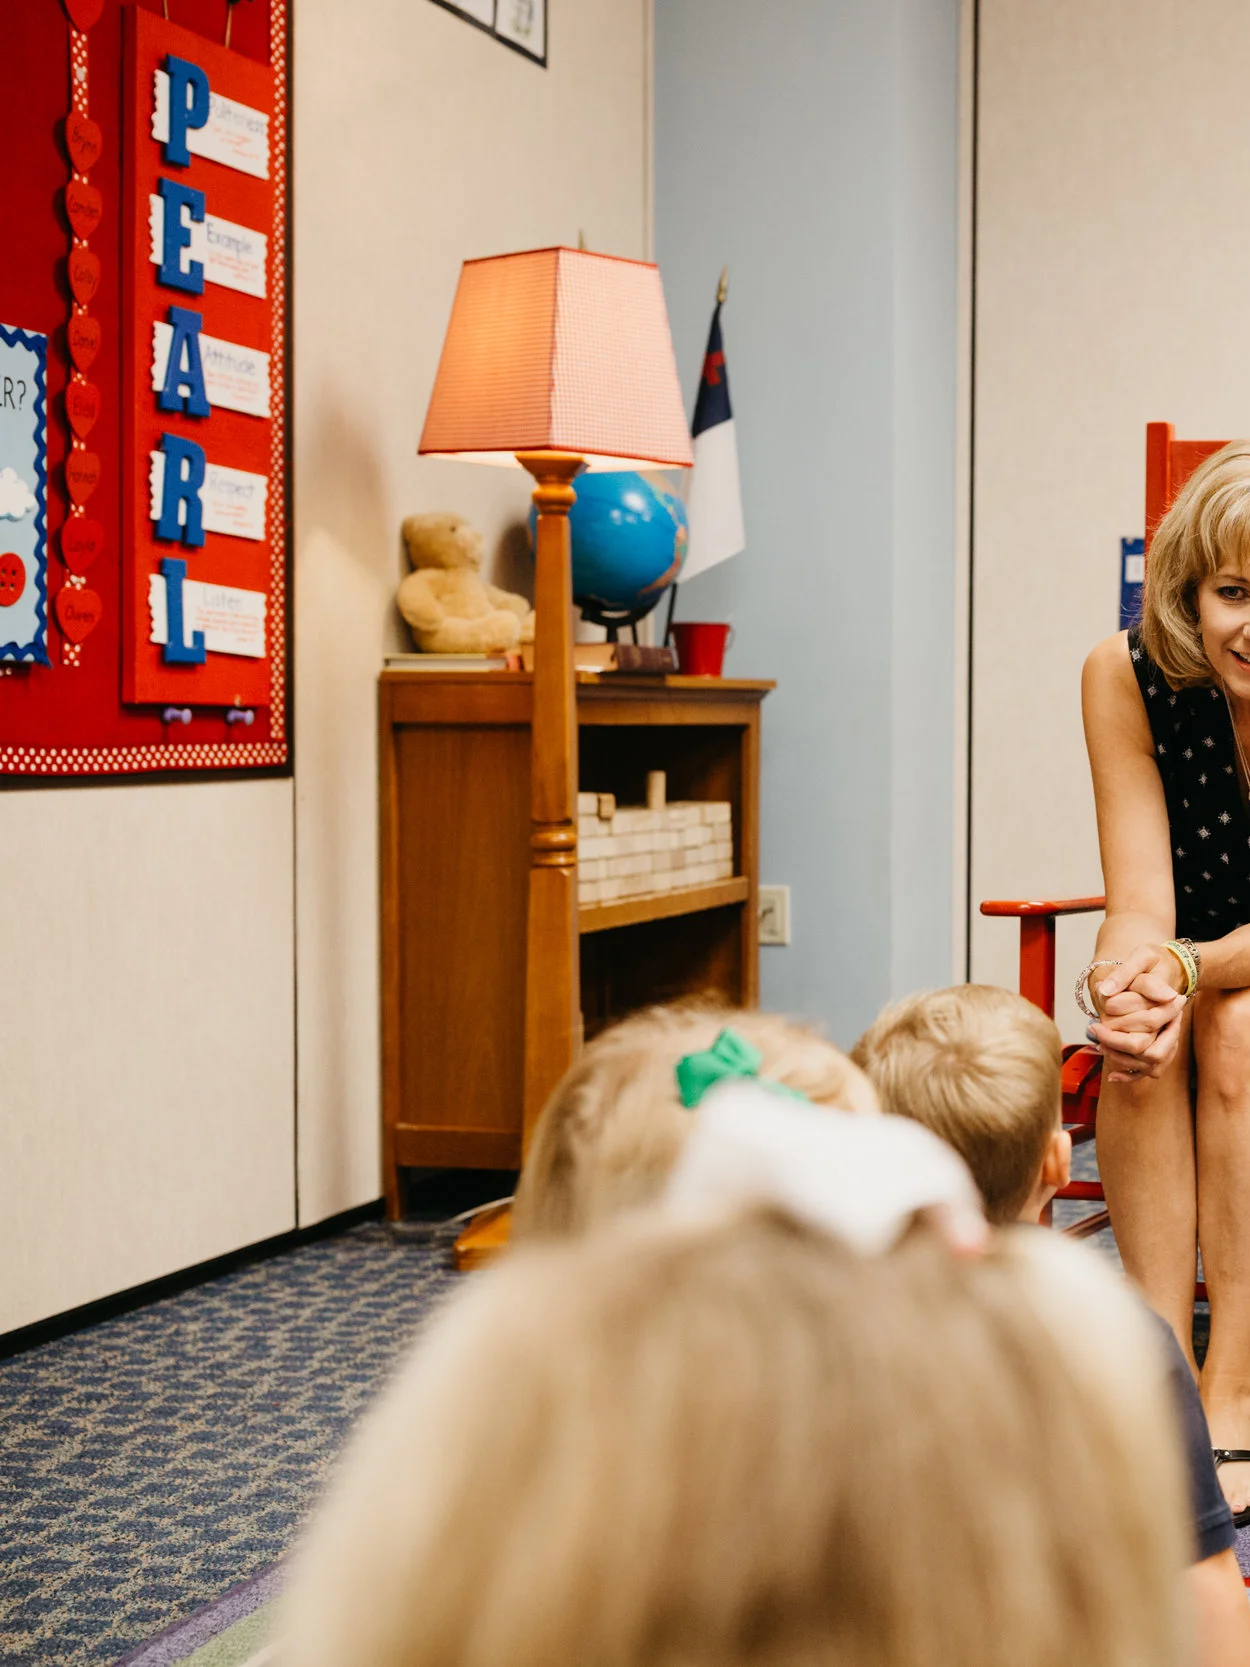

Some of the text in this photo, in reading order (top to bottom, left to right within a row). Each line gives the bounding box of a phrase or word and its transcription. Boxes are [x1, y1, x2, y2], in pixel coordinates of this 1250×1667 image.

[205, 222, 254, 259] Example
[156, 54, 211, 664] PEARL
[0, 376, 27, 411] R?
